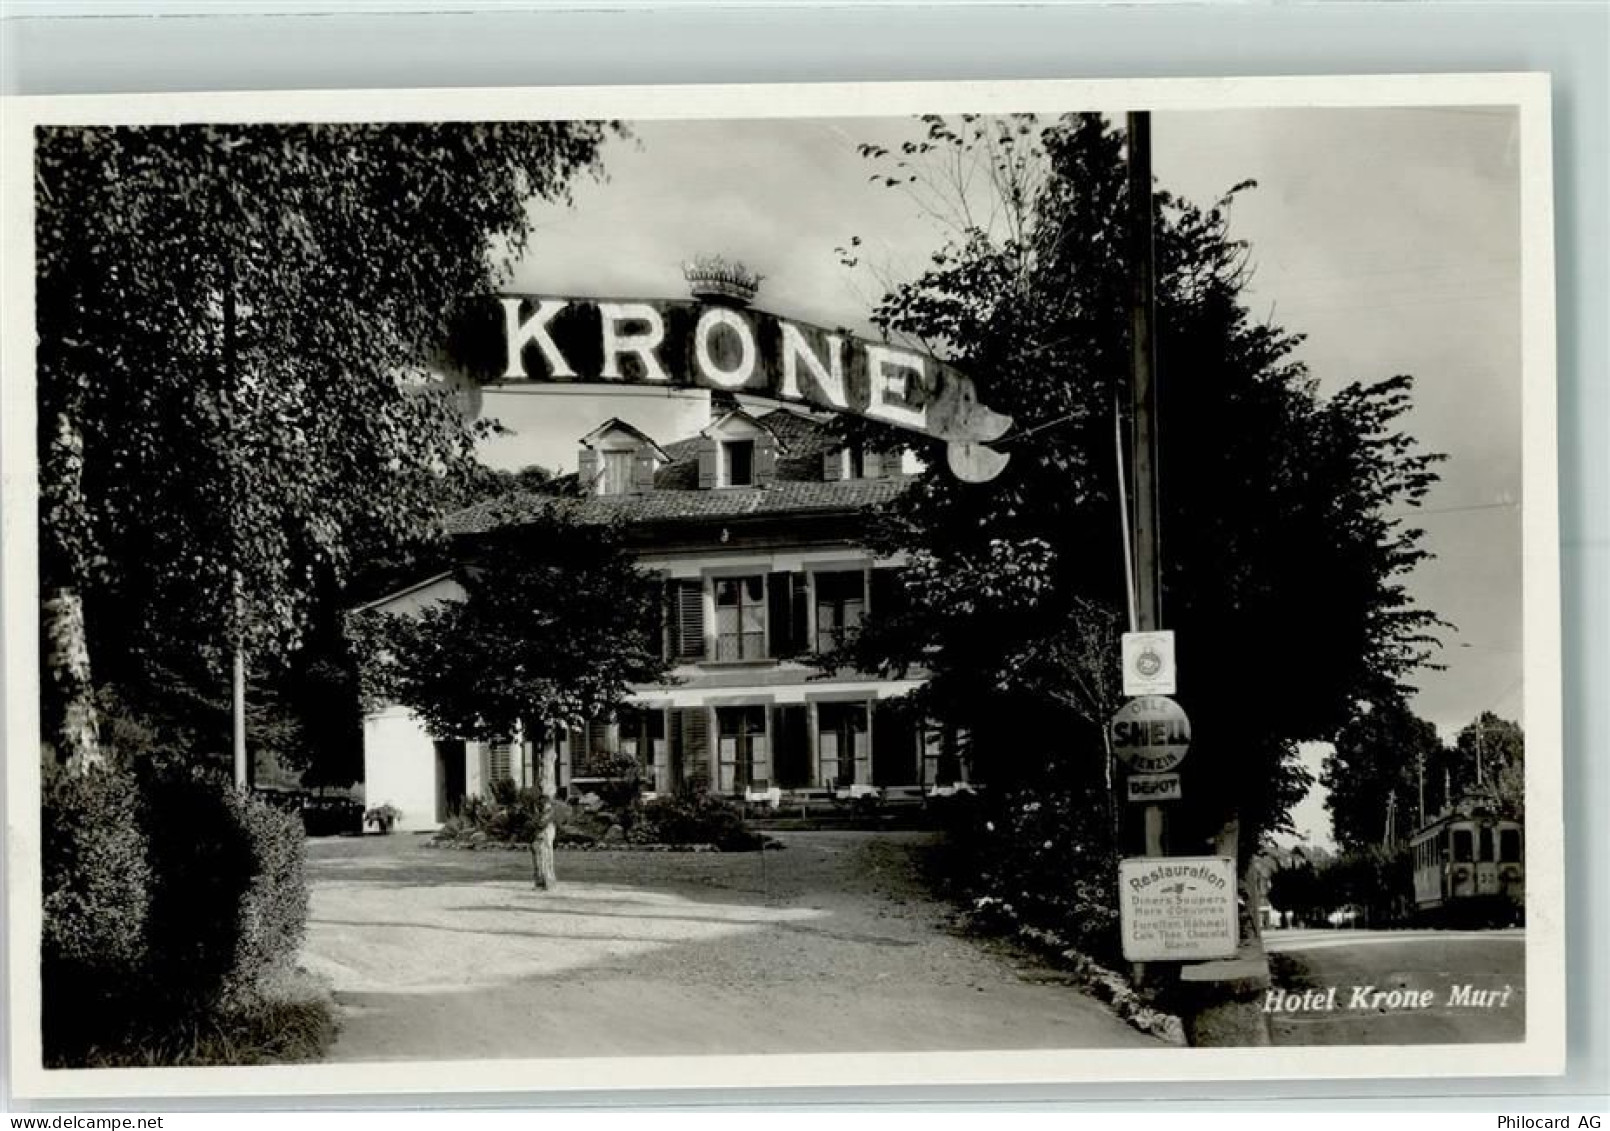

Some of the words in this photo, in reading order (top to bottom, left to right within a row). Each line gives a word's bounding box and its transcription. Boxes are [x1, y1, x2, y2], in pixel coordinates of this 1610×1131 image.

[500, 297, 927, 427] KRONE
[1114, 720, 1191, 746] SHELL
[1131, 778, 1178, 795] DEPOT
[1129, 865, 1226, 893] Restauration
